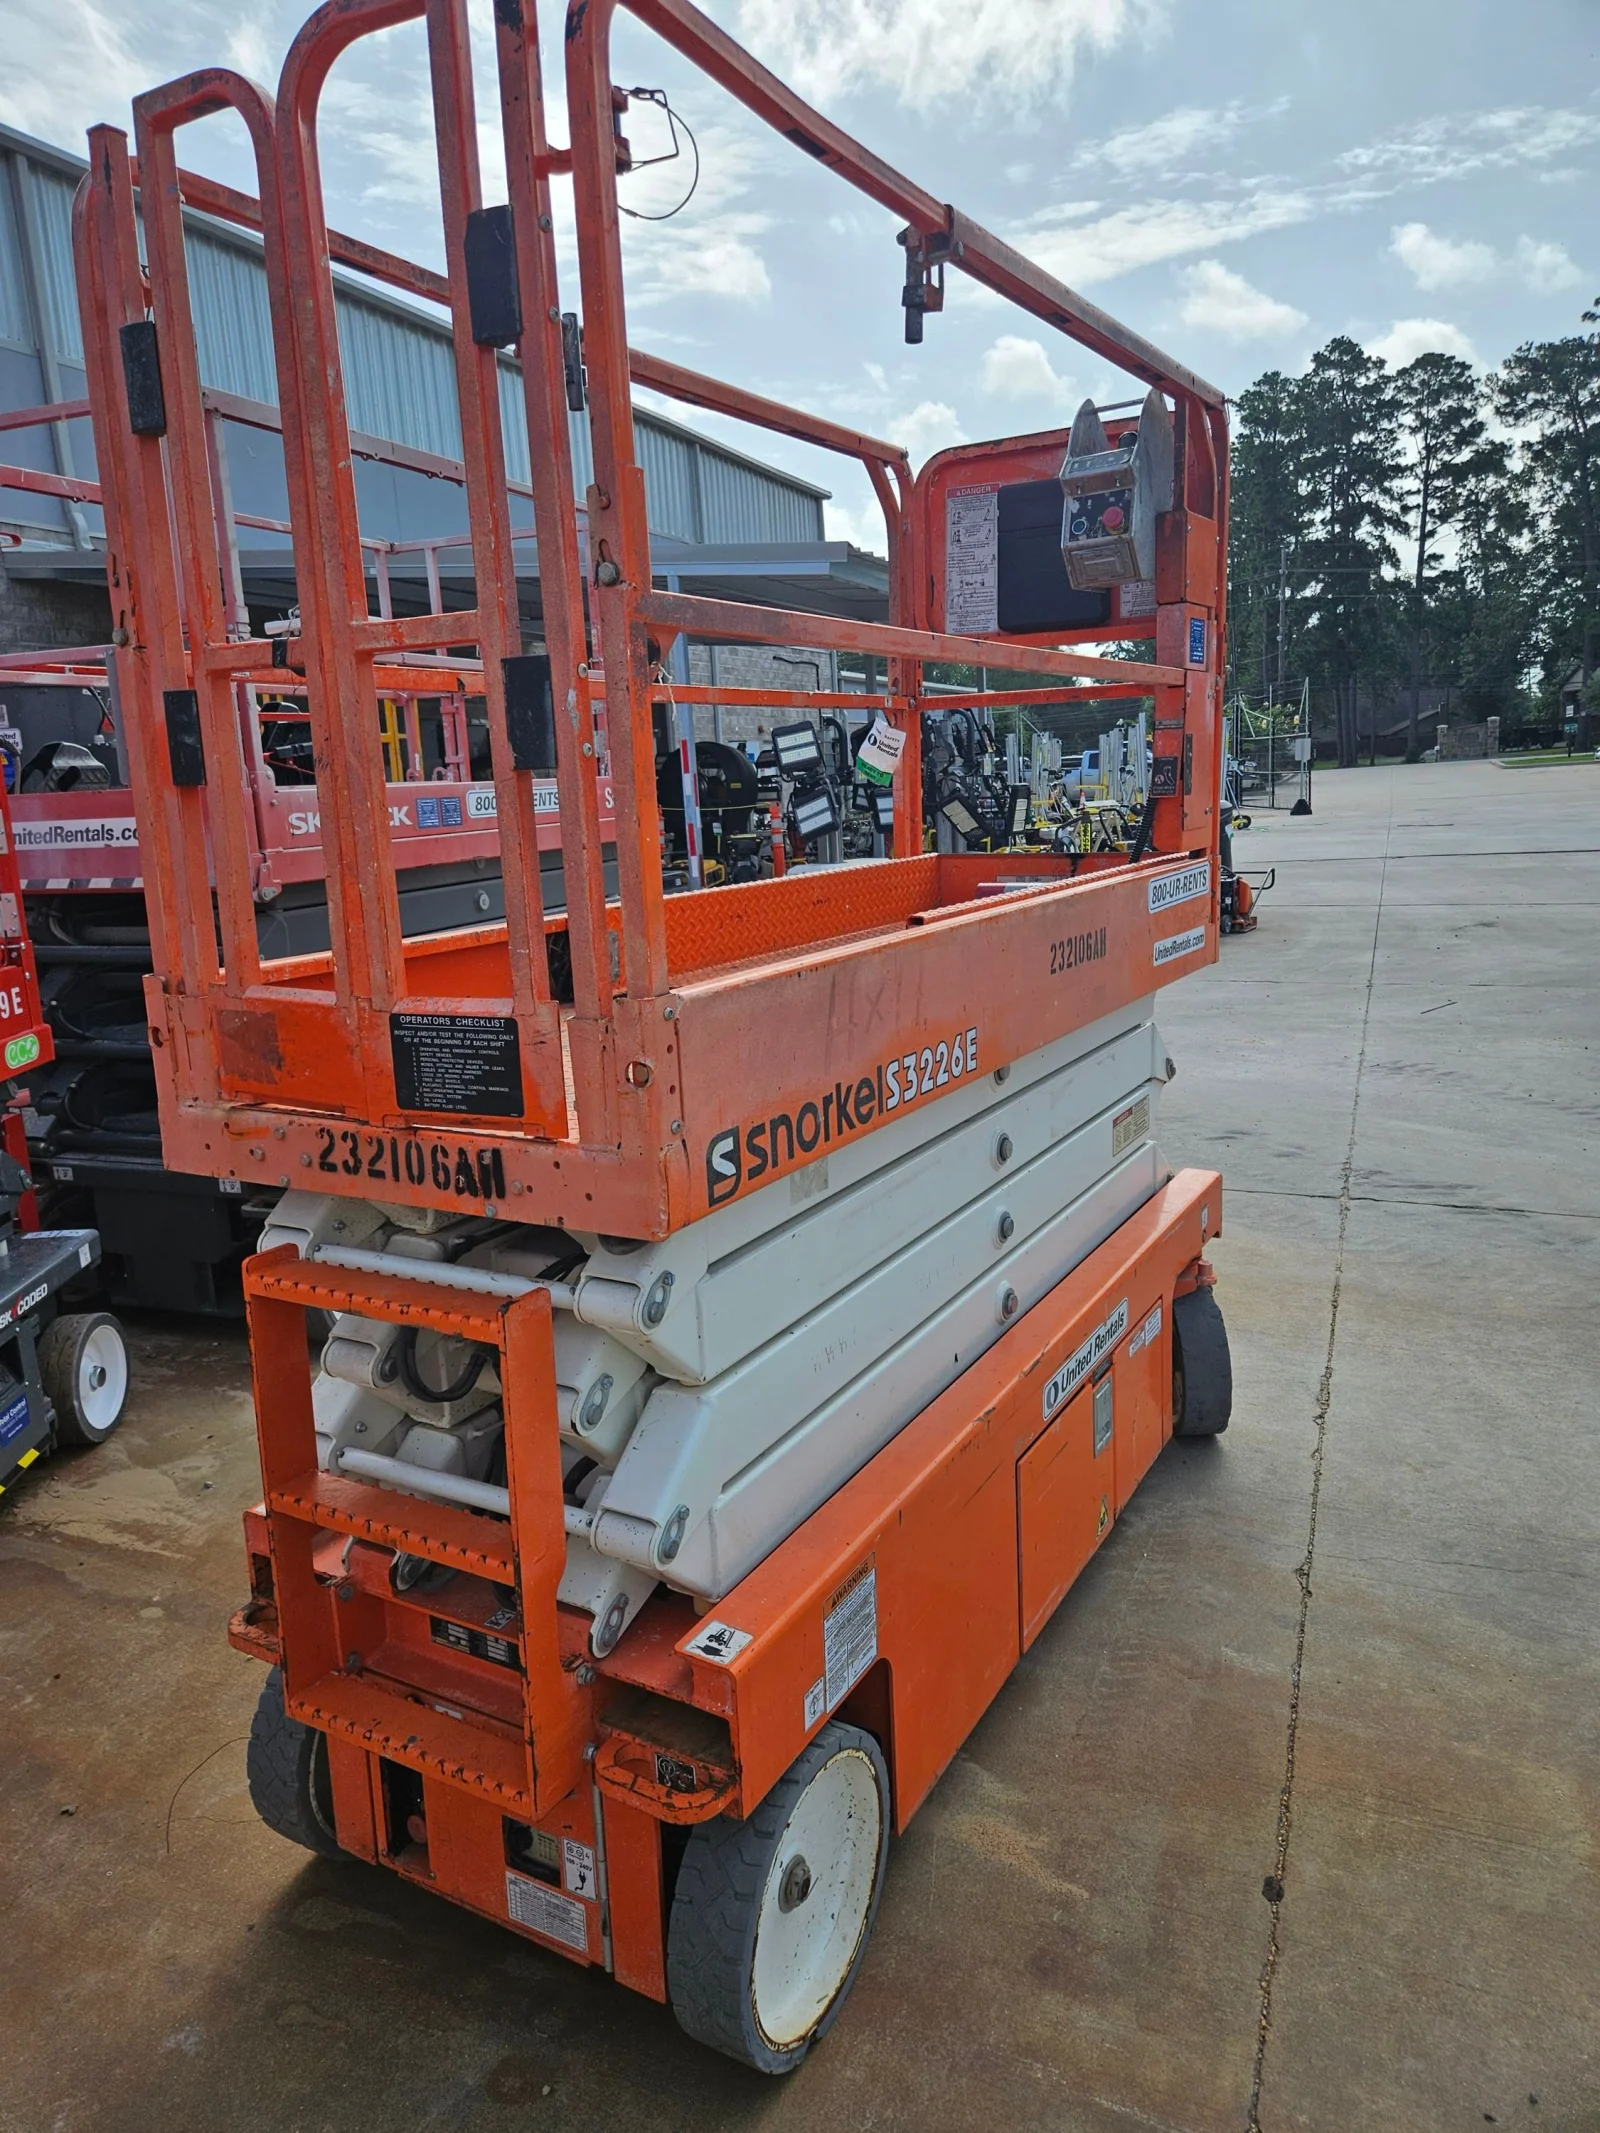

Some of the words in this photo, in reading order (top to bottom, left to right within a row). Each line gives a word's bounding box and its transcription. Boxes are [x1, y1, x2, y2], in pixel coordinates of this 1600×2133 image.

[961, 485, 991, 496] DANGER
[877, 744, 898, 758] Rentals
[878, 739, 899, 752] United
[1152, 869, 1207, 905] 800-UR-RENTS
[1155, 933, 1204, 962] UnitedRentals.com
[400, 1015, 450, 1025] OPERATORS
[456, 1018, 505, 1027] CHECKLIST
[8, 1037, 38, 1066] eco
[746, 1065, 885, 1181] snorkel
[885, 1027, 978, 1113] S3226E
[1061, 1343, 1093, 1393] United
[1094, 1311, 1126, 1357] Rentals
[835, 1562, 869, 1603] WARNING
